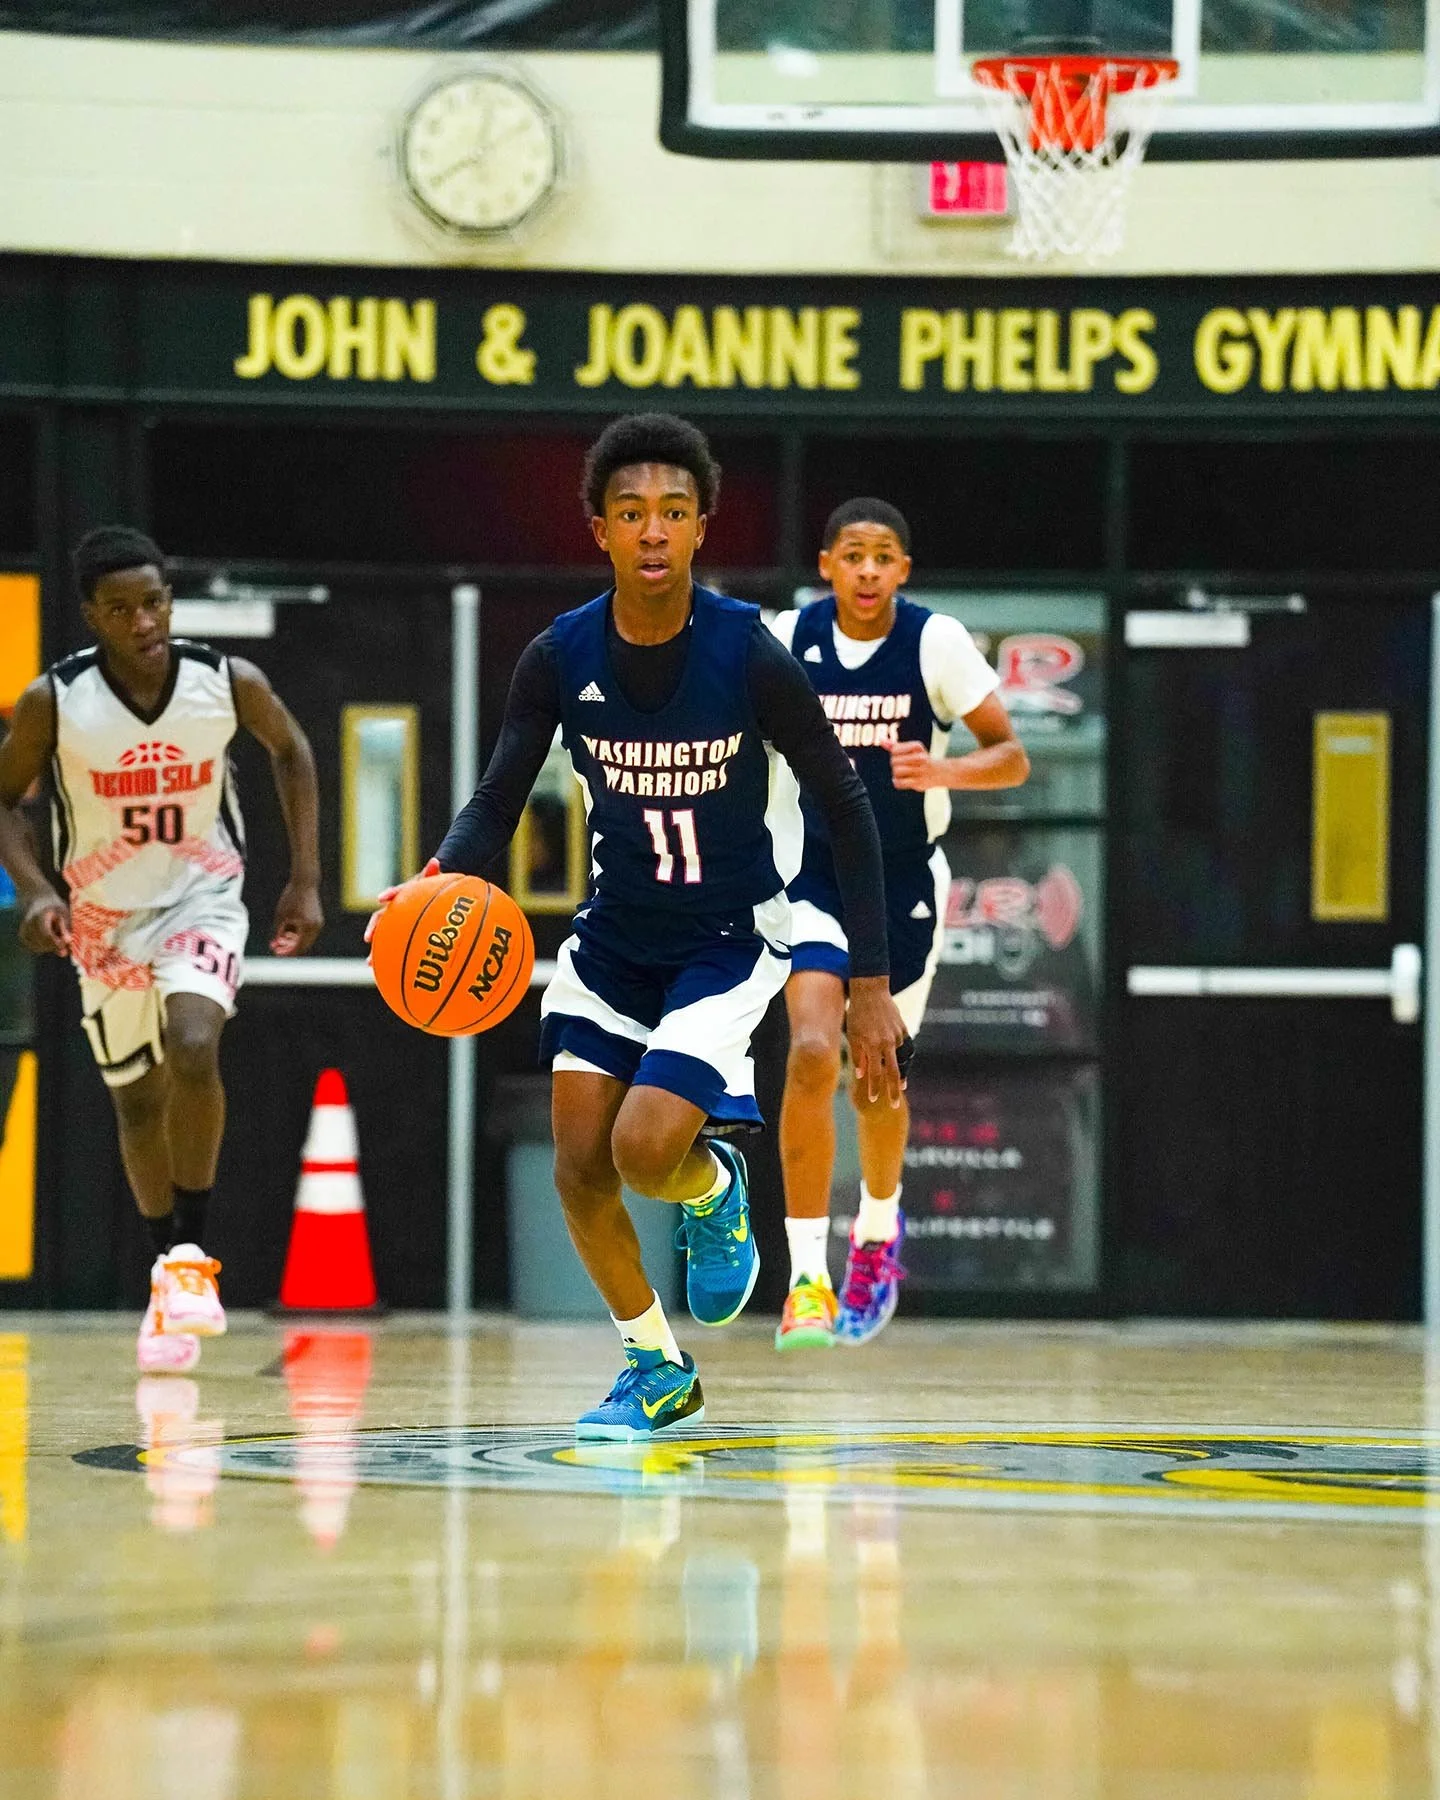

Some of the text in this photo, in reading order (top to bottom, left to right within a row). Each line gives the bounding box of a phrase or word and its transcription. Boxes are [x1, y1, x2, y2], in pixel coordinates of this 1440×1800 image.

[234, 293, 437, 383] JOHN
[475, 303, 538, 386] &
[574, 303, 861, 391] JOANNE
[900, 306, 1159, 395] PHELPS
[88, 758, 214, 798] TEAM SILK
[581, 732, 743, 768] WASHINGTON
[602, 762, 728, 797] WARRIORS
[122, 803, 184, 845] 50
[643, 808, 702, 884] 11
[413, 896, 475, 993] Wilson
[468, 926, 513, 1002] NCAA
